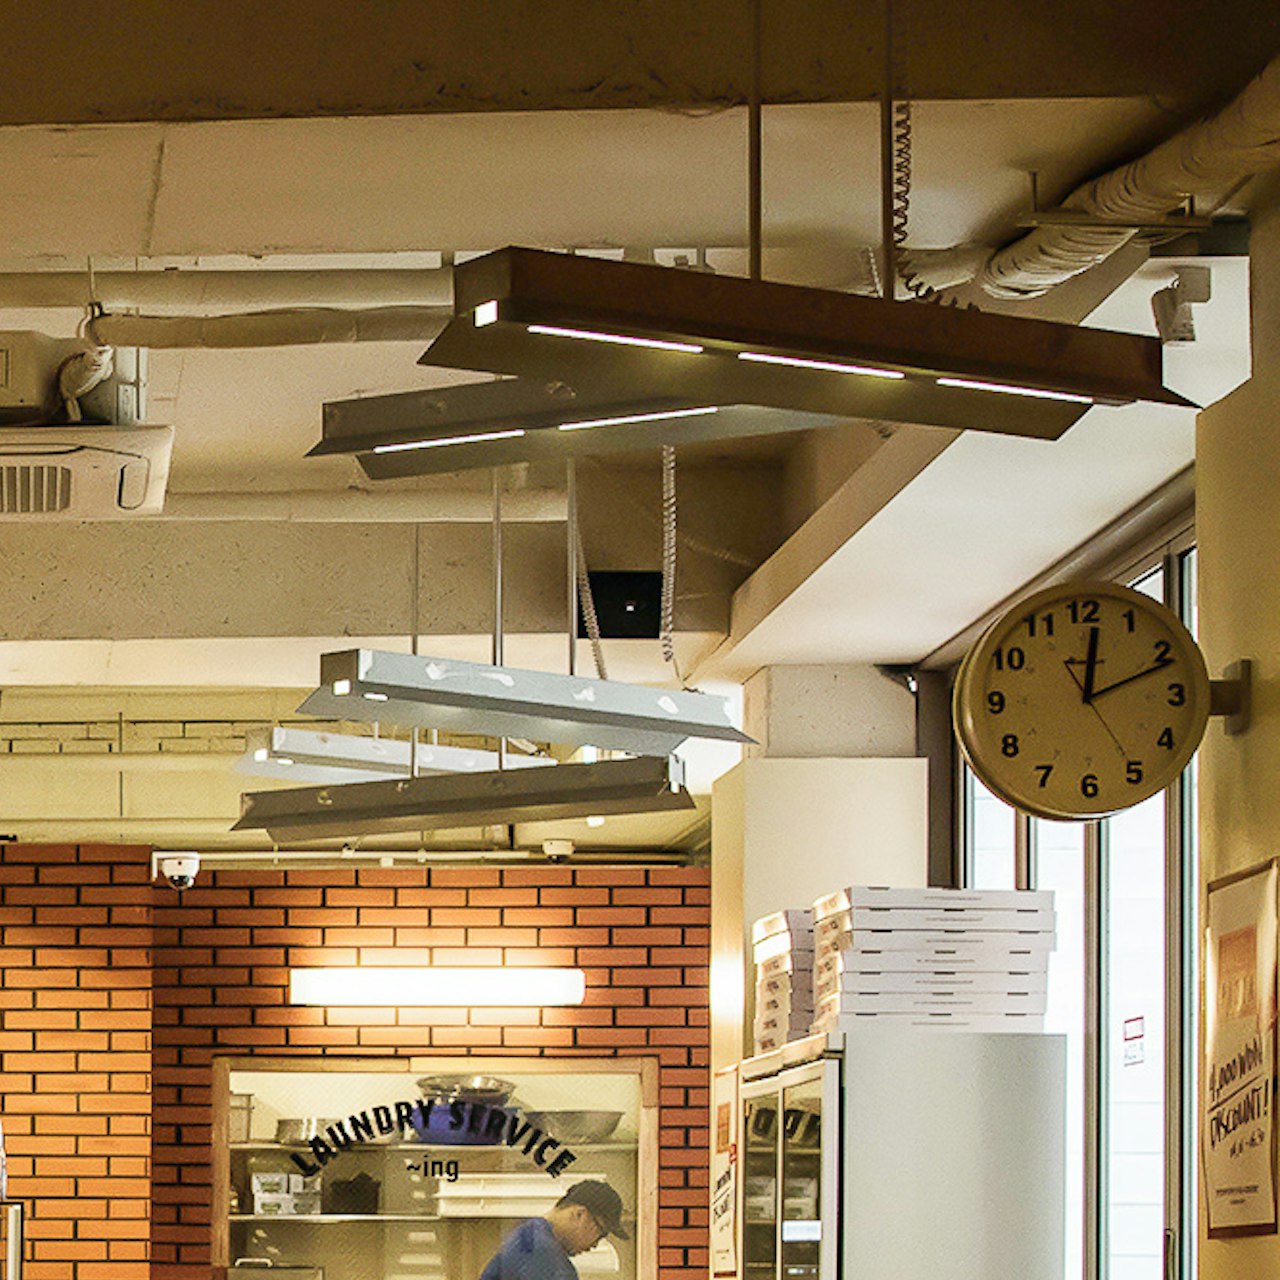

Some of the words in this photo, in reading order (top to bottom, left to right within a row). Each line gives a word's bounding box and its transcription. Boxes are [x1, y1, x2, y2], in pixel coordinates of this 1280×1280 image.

[1066, 601, 1100, 623] 12
[1122, 610, 1135, 632] 1
[1023, 614, 1054, 637] 11
[992, 648, 1024, 671] 10
[1154, 641, 1171, 662] 2
[988, 691, 1005, 714] 9
[1168, 684, 1185, 706] 3
[1001, 735, 1019, 757] 8
[1157, 728, 1174, 750] 4
[1035, 765, 1053, 788] 7
[1126, 762, 1142, 784] 5
[1081, 775, 1098, 798] 6
[290, 1099, 436, 1176] LAUNDRY
[449, 1101, 577, 1179] SERVICE
